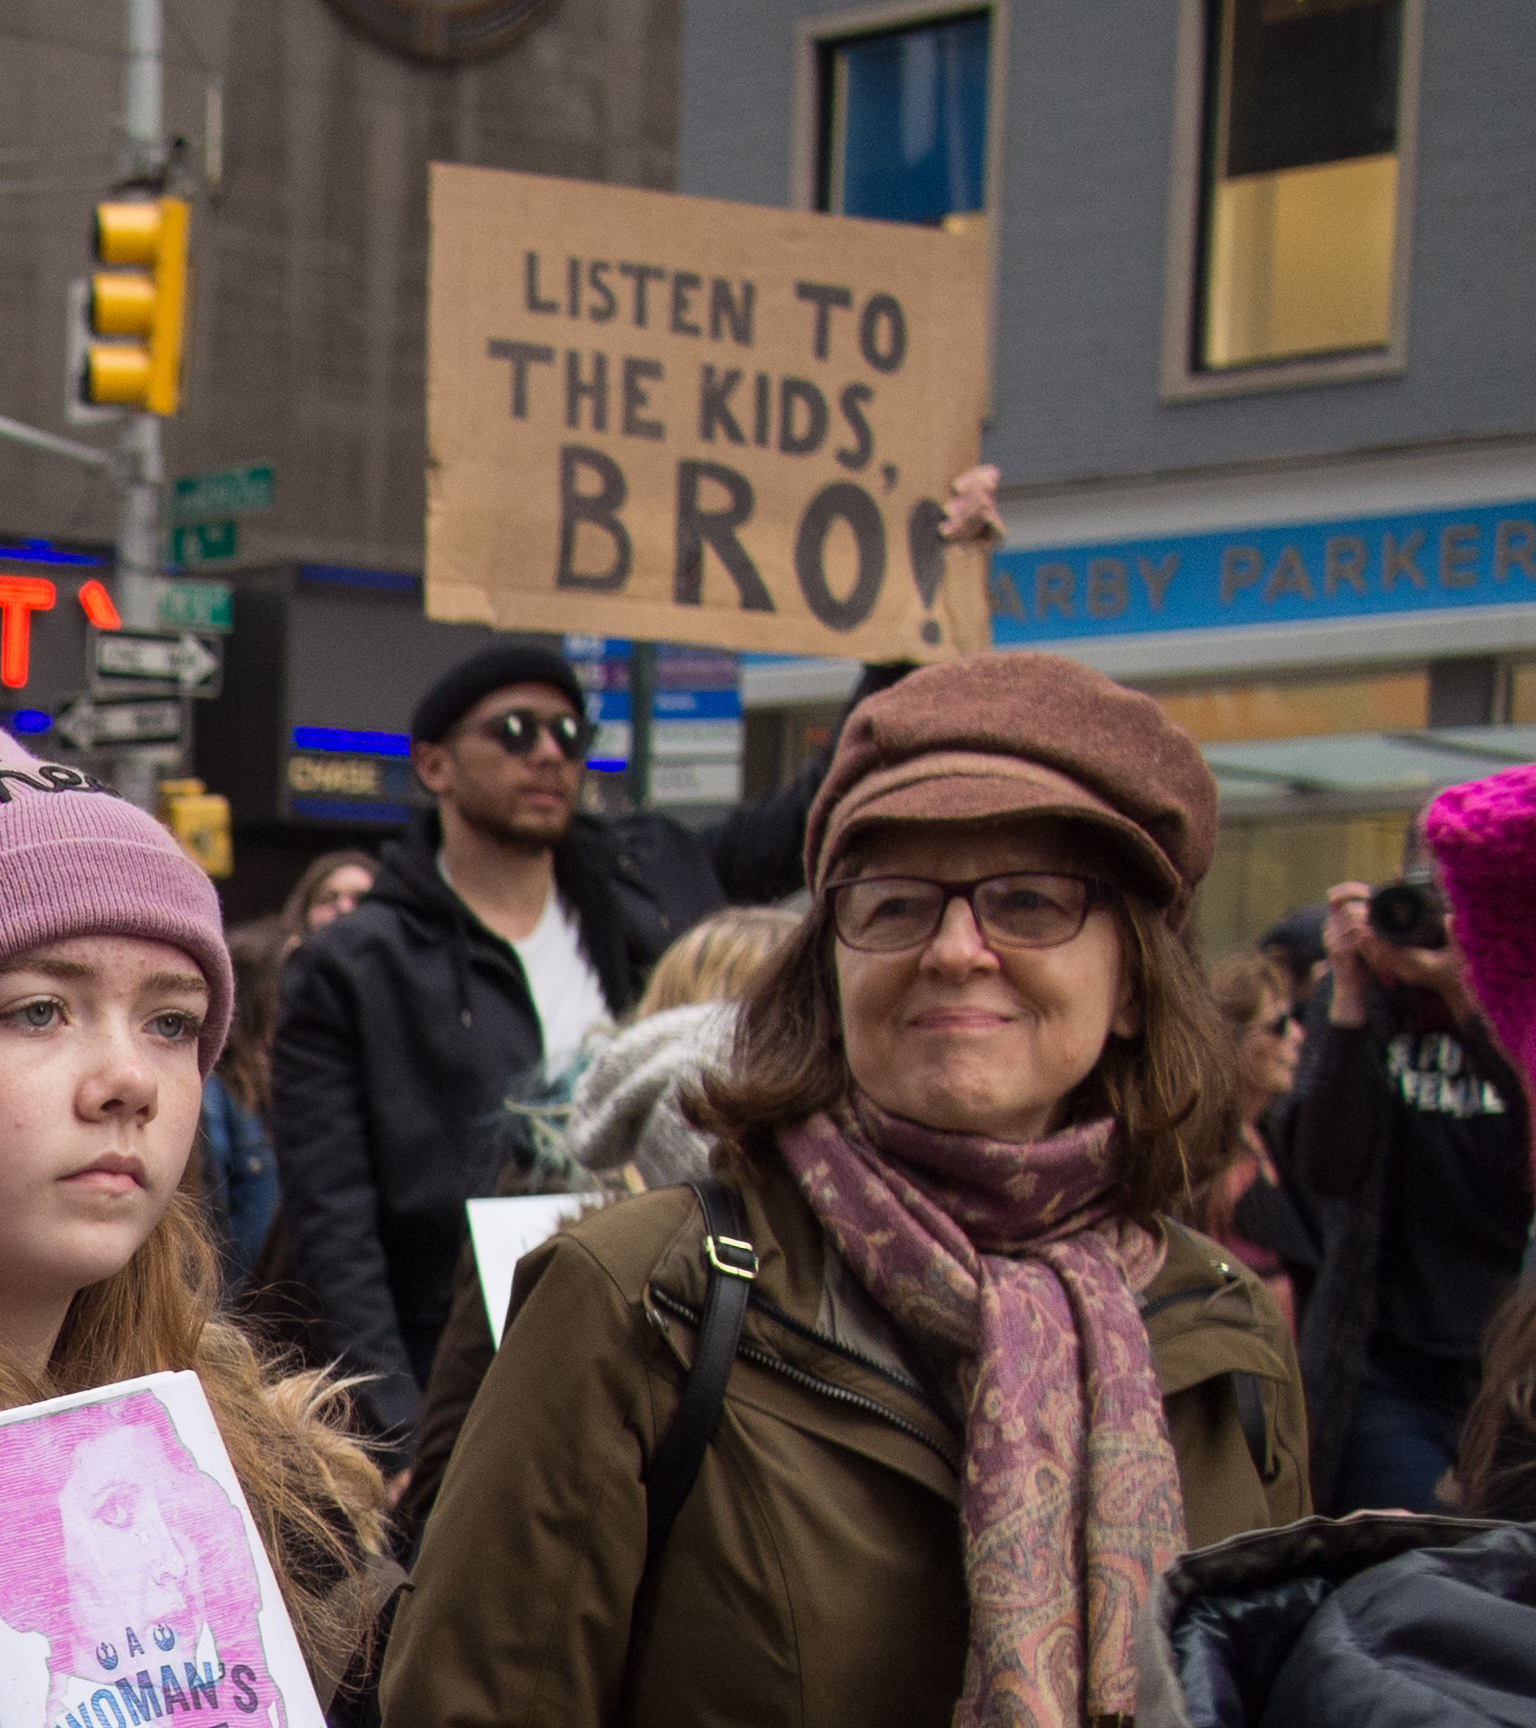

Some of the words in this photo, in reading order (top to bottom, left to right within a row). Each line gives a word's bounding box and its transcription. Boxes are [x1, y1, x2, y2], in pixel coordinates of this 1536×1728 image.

[524, 250, 757, 347] LISTEN
[795, 280, 907, 374] TO
[485, 337, 667, 442] THE
[699, 361, 898, 493] KIDS,
[555, 443, 947, 646] BRO!
[990, 552, 1182, 623] ARBY
[1219, 518, 1536, 609] PARKER
[126, 1627, 146, 1658] A
